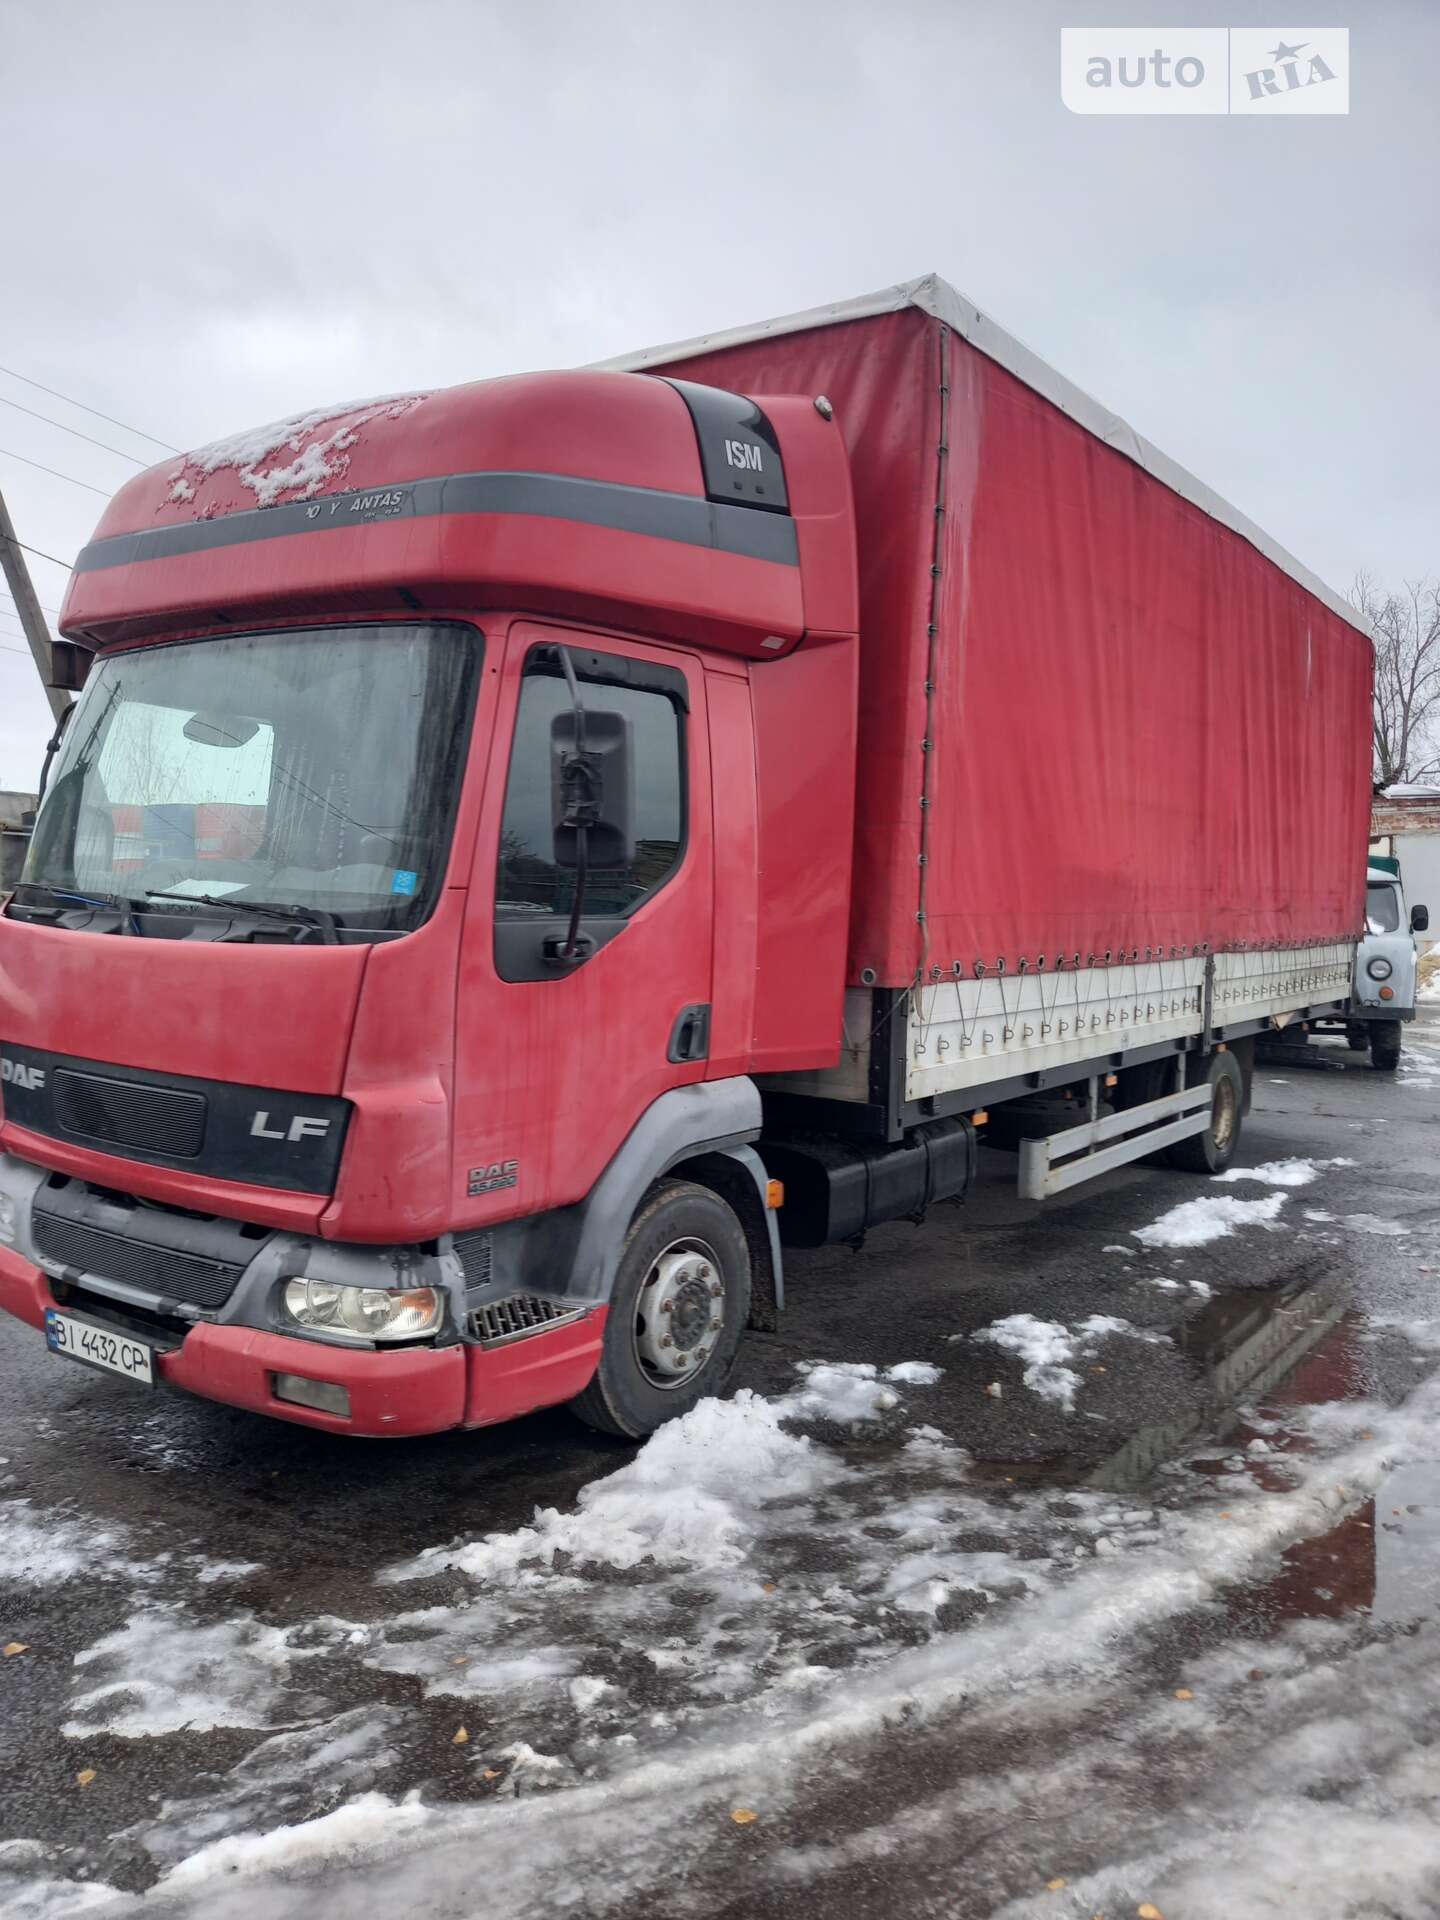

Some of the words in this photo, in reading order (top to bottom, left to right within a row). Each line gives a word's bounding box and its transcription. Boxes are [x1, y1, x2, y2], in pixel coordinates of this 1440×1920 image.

[725, 439, 763, 472] ISM
[350, 491, 403, 512] ANTAS
[0, 1057, 46, 1090] DAF
[250, 1111, 331, 1142] LF
[469, 1160, 519, 1181] DAF
[56, 1321, 74, 1350] BI
[82, 1331, 118, 1365] 4432
[121, 1345, 144, 1372] CP
